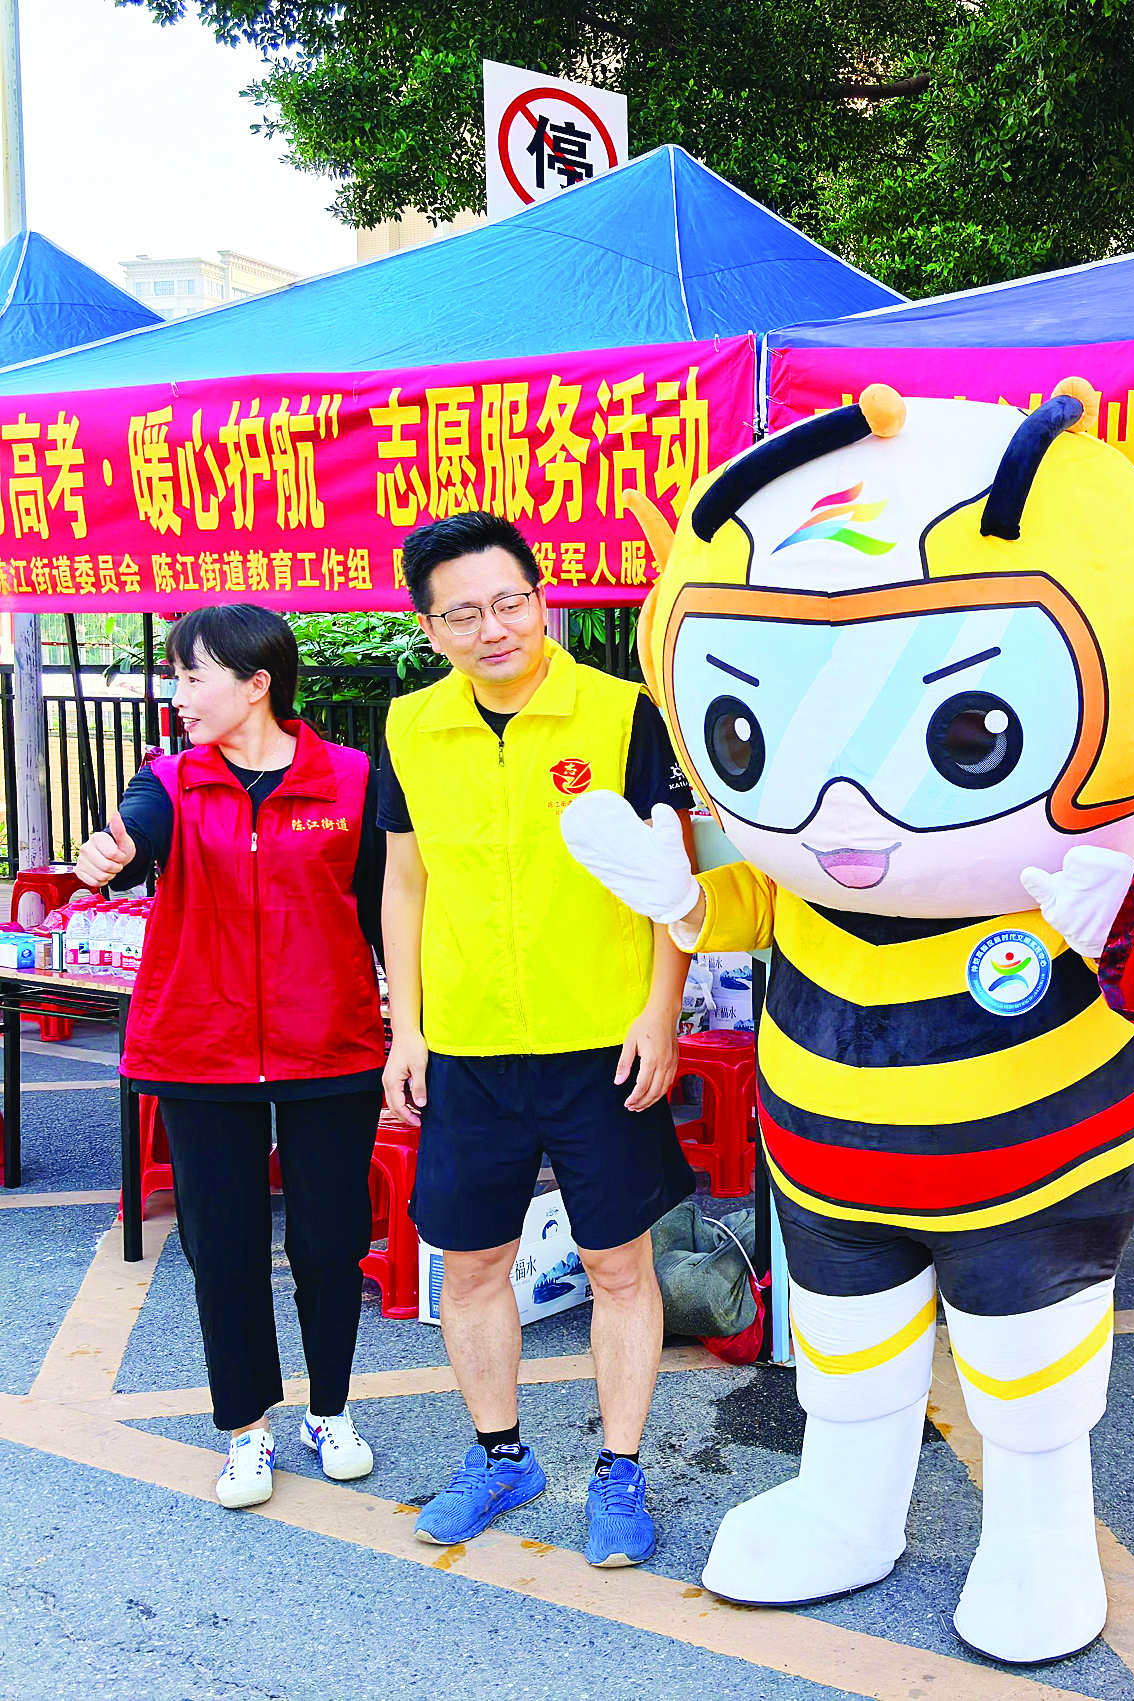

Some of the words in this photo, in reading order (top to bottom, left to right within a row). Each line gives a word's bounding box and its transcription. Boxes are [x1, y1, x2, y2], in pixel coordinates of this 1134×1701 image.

[526, 114, 593, 189] 停
[0, 394, 343, 540] 高考·暖心护航”
[369, 366, 708, 526] 志愿服务活动
[152, 548, 373, 594] 陈江街道教育工作组
[291, 817, 350, 832] 陈江街道
[509, 1255, 537, 1282] 福水
